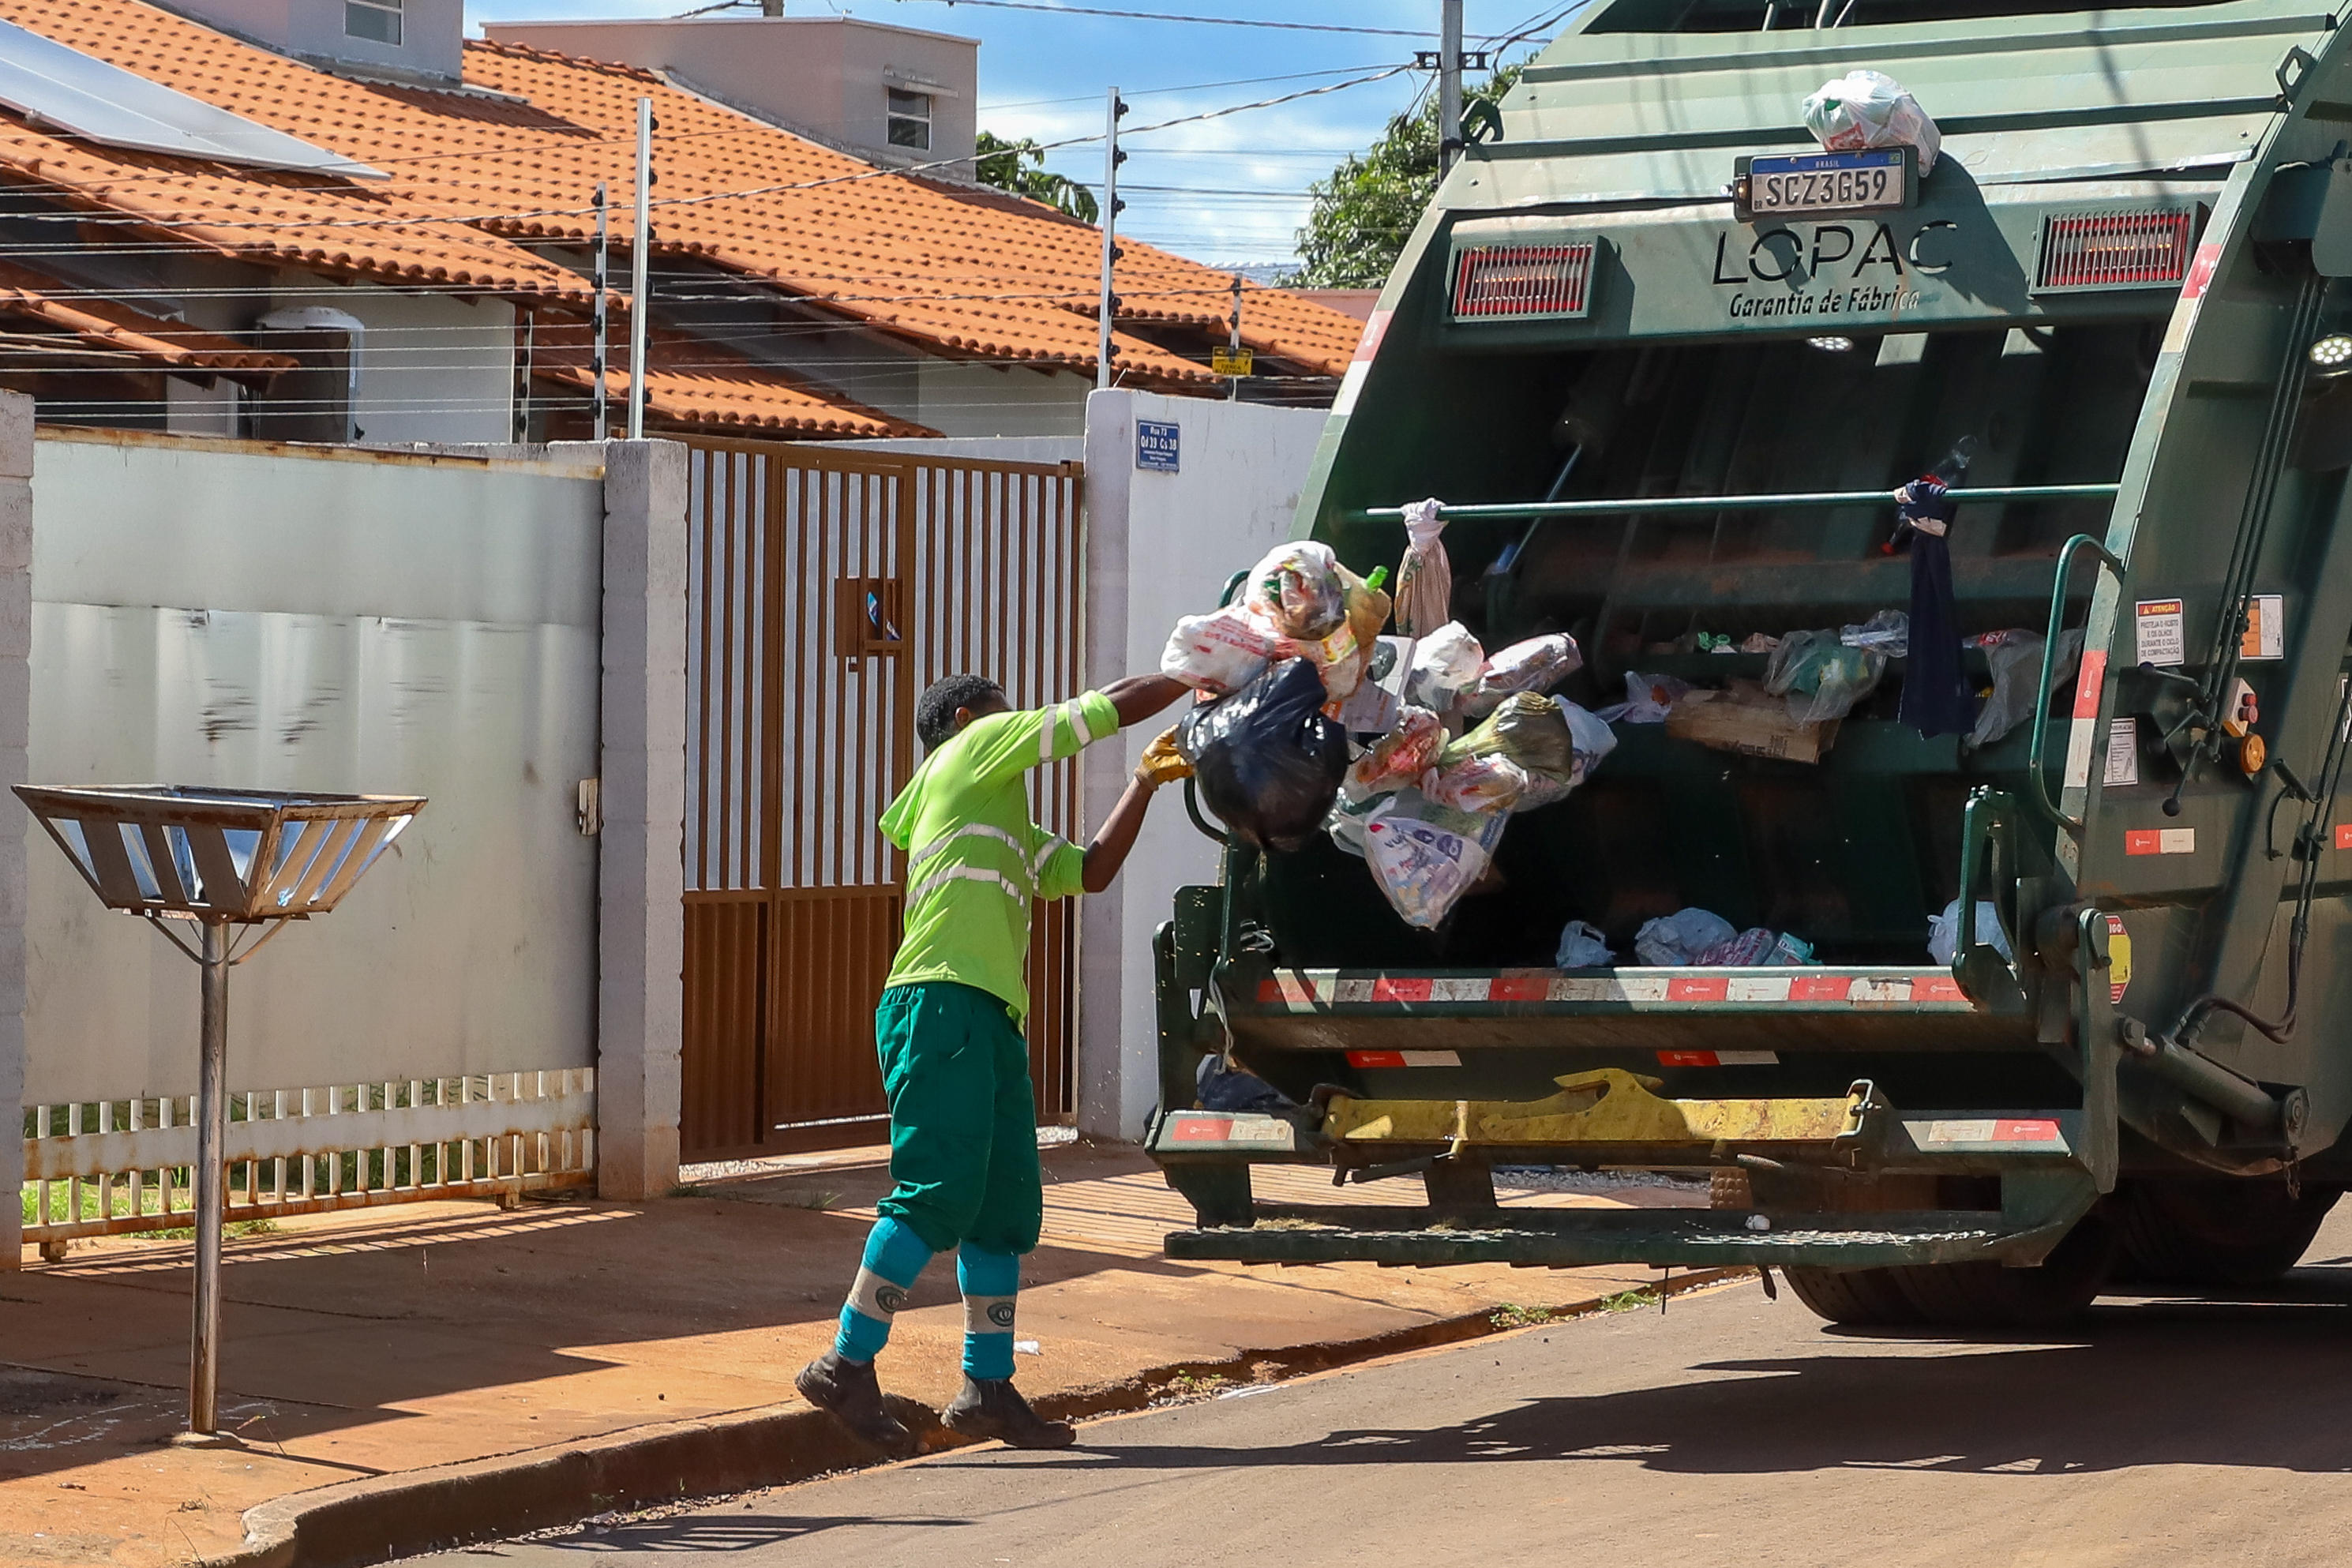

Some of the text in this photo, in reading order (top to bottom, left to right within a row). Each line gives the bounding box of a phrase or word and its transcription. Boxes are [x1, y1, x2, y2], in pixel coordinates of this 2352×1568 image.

[1765, 169, 1887, 207] SCZ3G59
[1712, 219, 1959, 285] LOPAC
[1729, 284, 1920, 317] Garantia de Fábrica
[2151, 603, 2176, 613] ATENÇÃO
